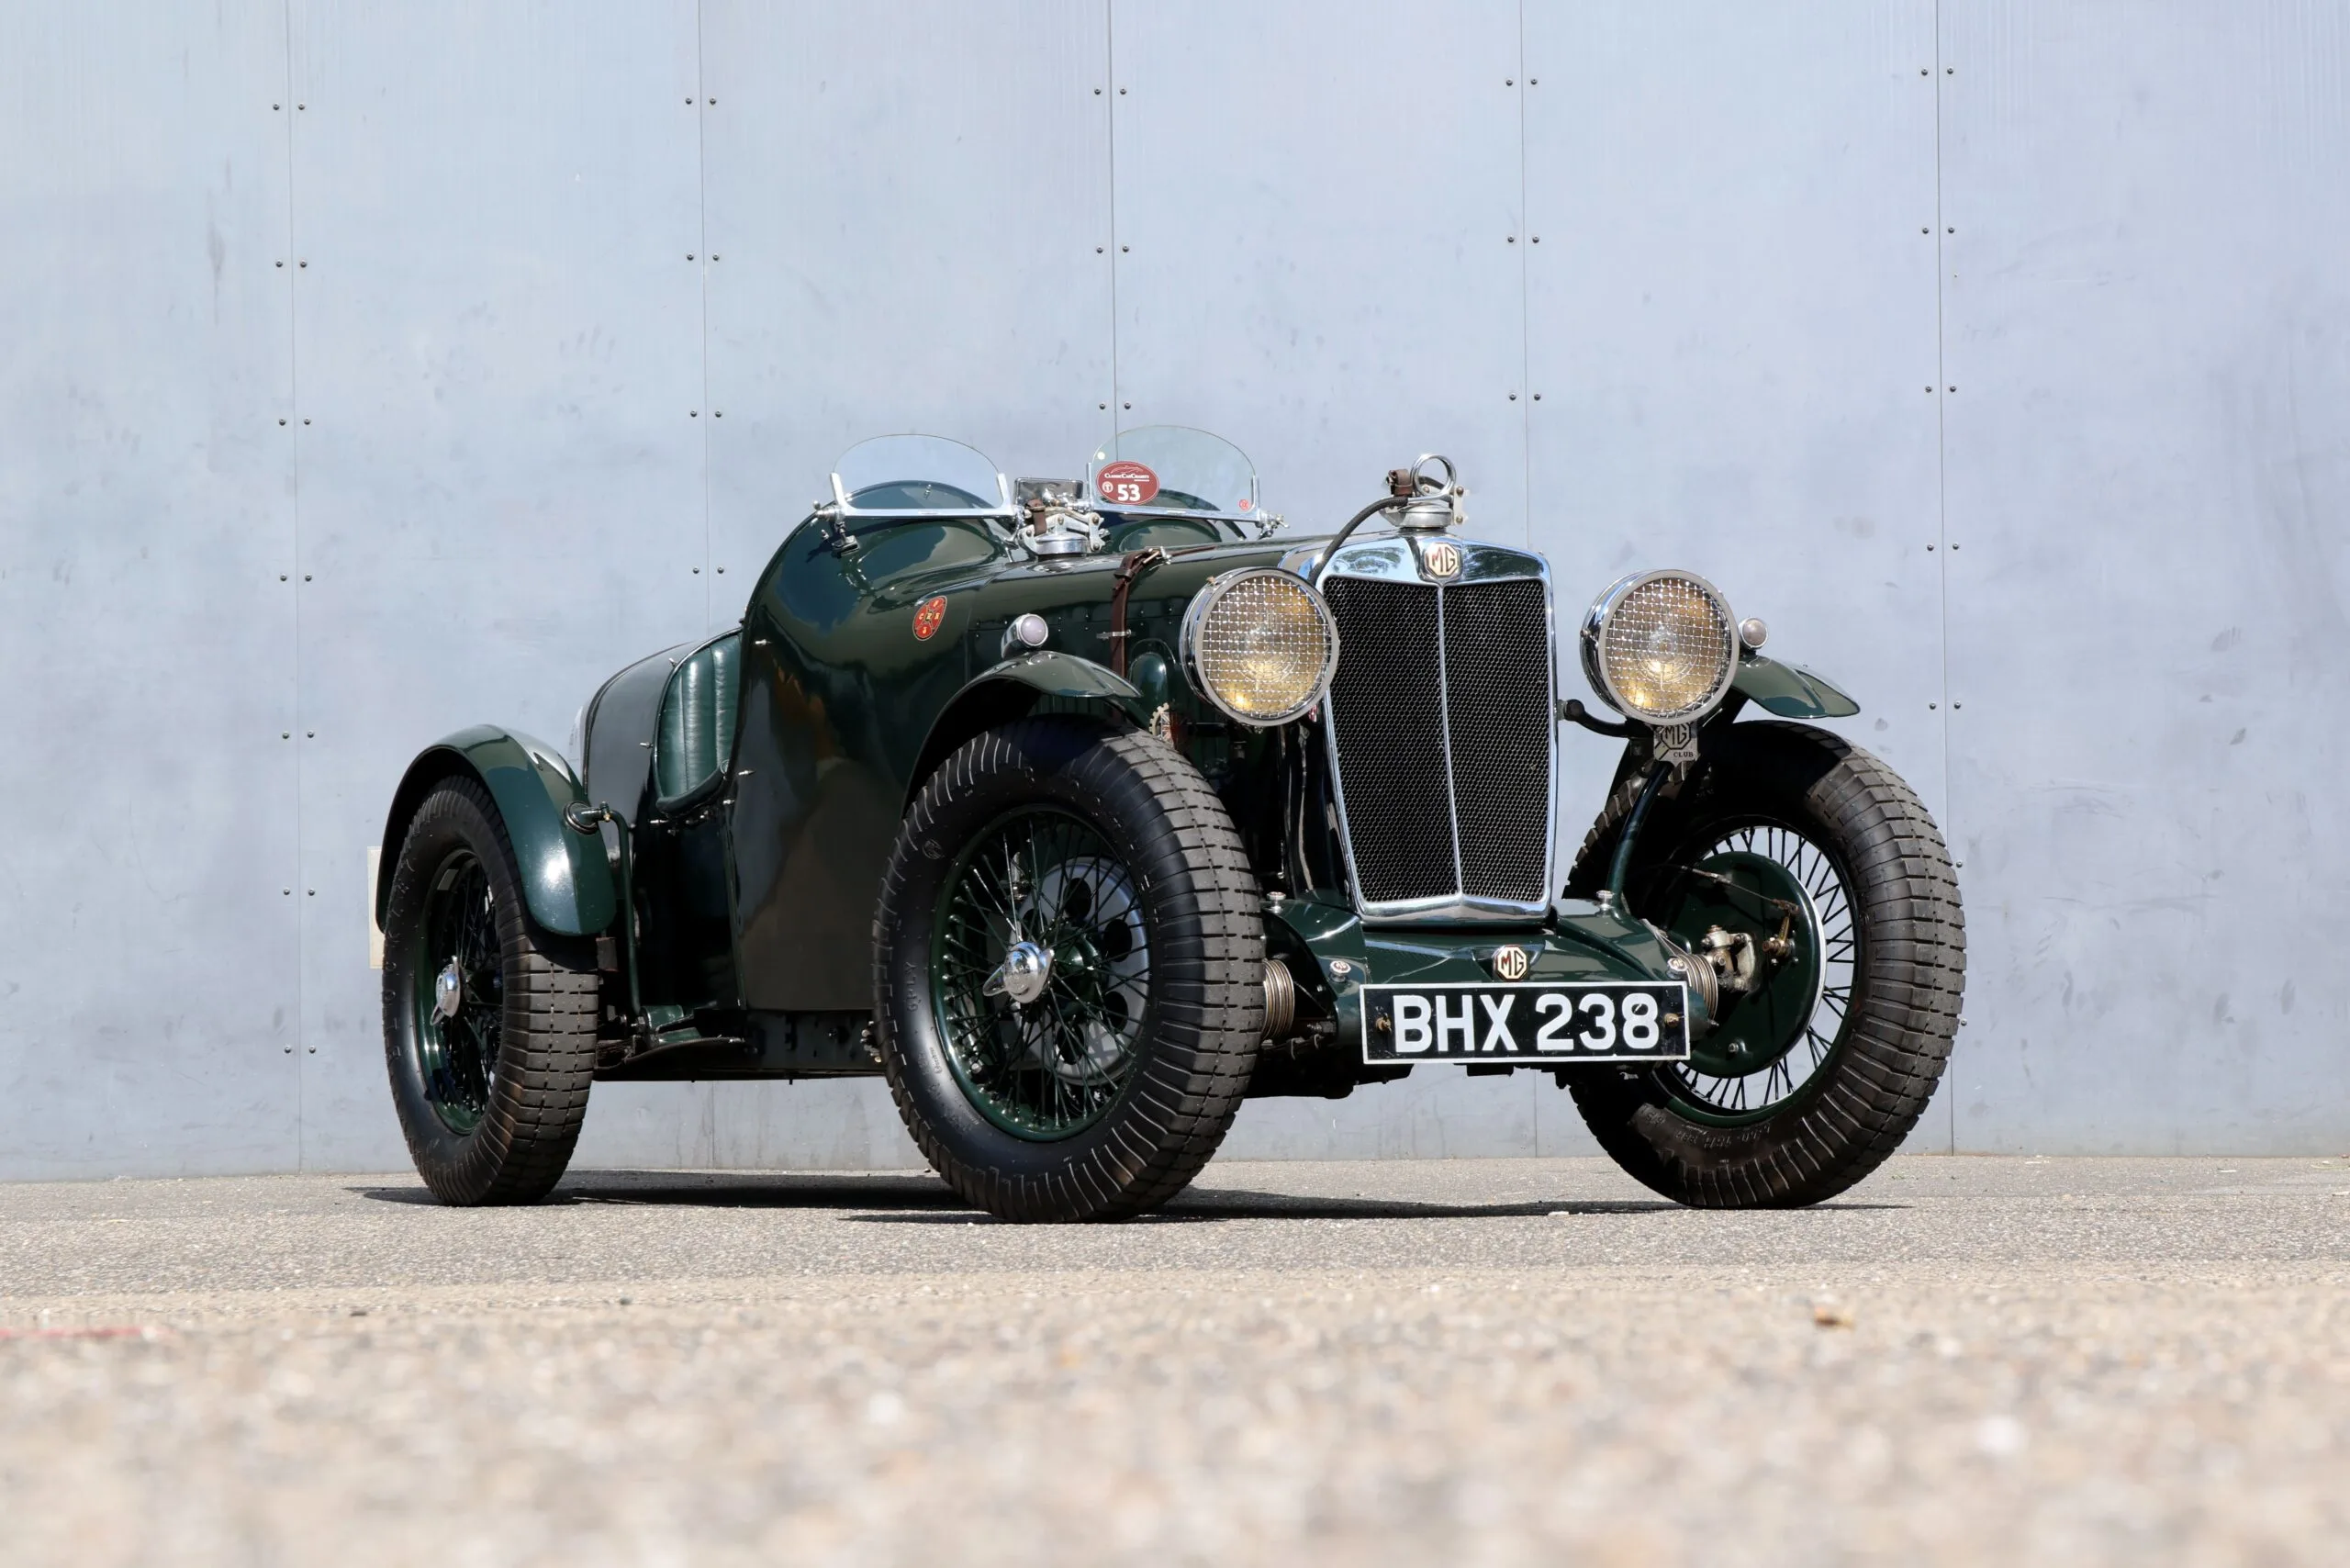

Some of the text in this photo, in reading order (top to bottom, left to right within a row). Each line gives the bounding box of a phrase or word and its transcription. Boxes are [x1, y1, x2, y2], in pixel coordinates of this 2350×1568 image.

[1117, 484, 1141, 502] 53
[1431, 546, 1456, 573] MG
[1664, 722, 1688, 745] MG
[1500, 949, 1525, 977] MG
[1393, 992, 1660, 1053] BHX 238
